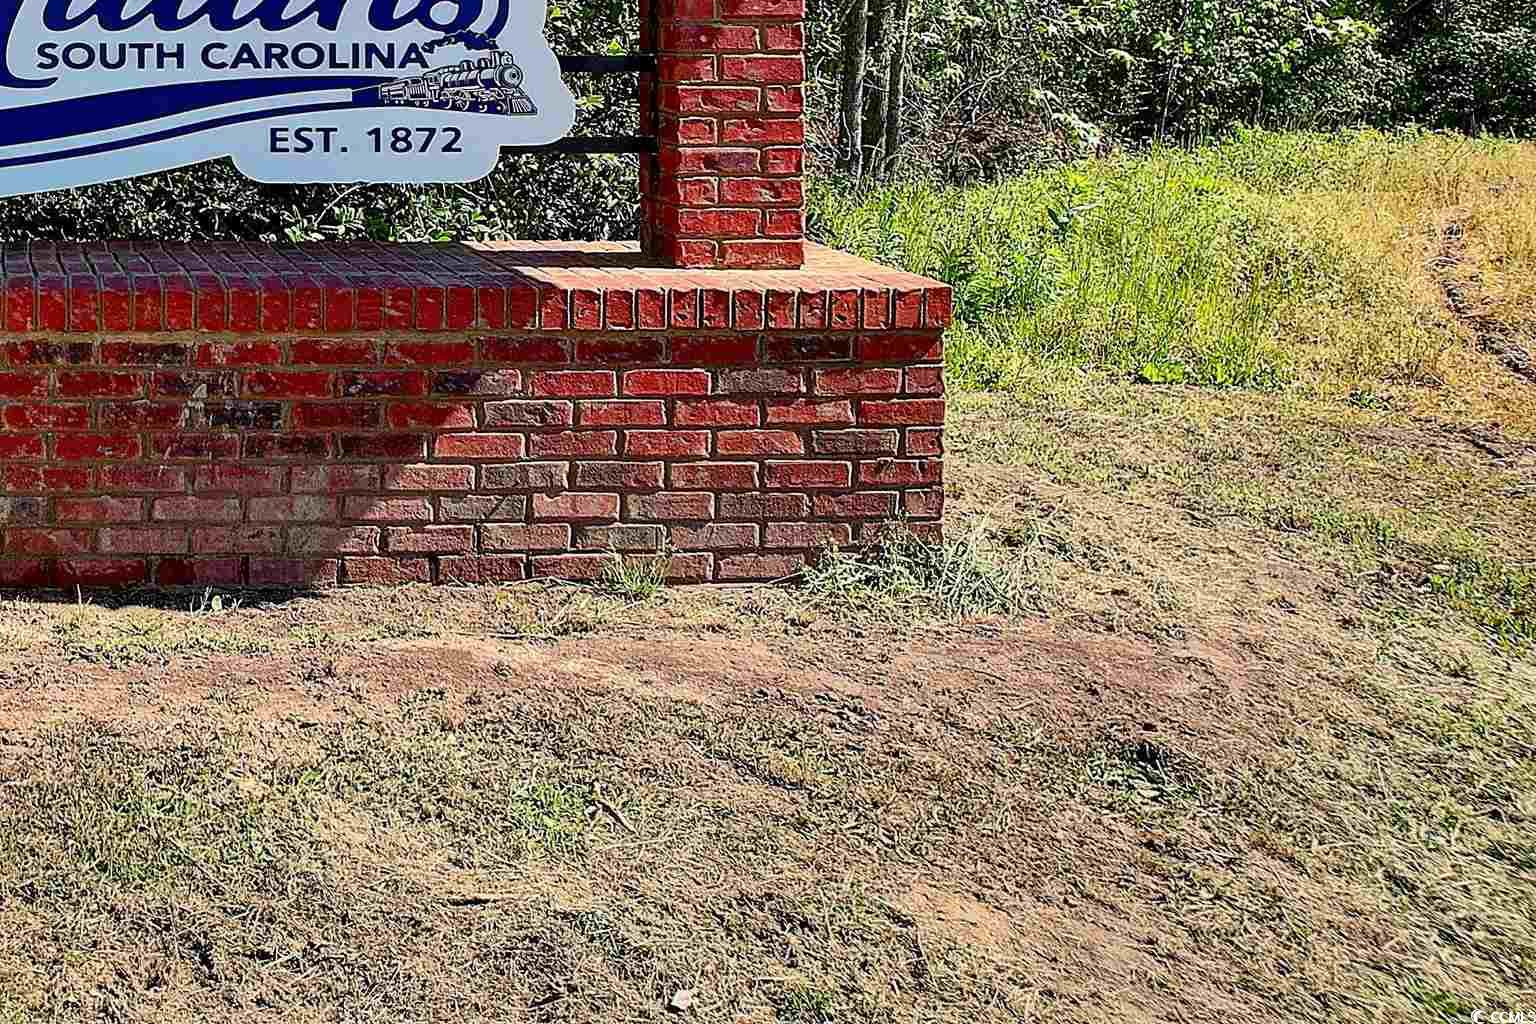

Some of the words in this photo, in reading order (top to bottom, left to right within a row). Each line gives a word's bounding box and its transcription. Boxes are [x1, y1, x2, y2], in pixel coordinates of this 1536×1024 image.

[37, 41, 185, 70] SOUTH
[200, 41, 431, 70] CAROLINA
[269, 126, 348, 154] EST.
[366, 126, 463, 154] 1872
